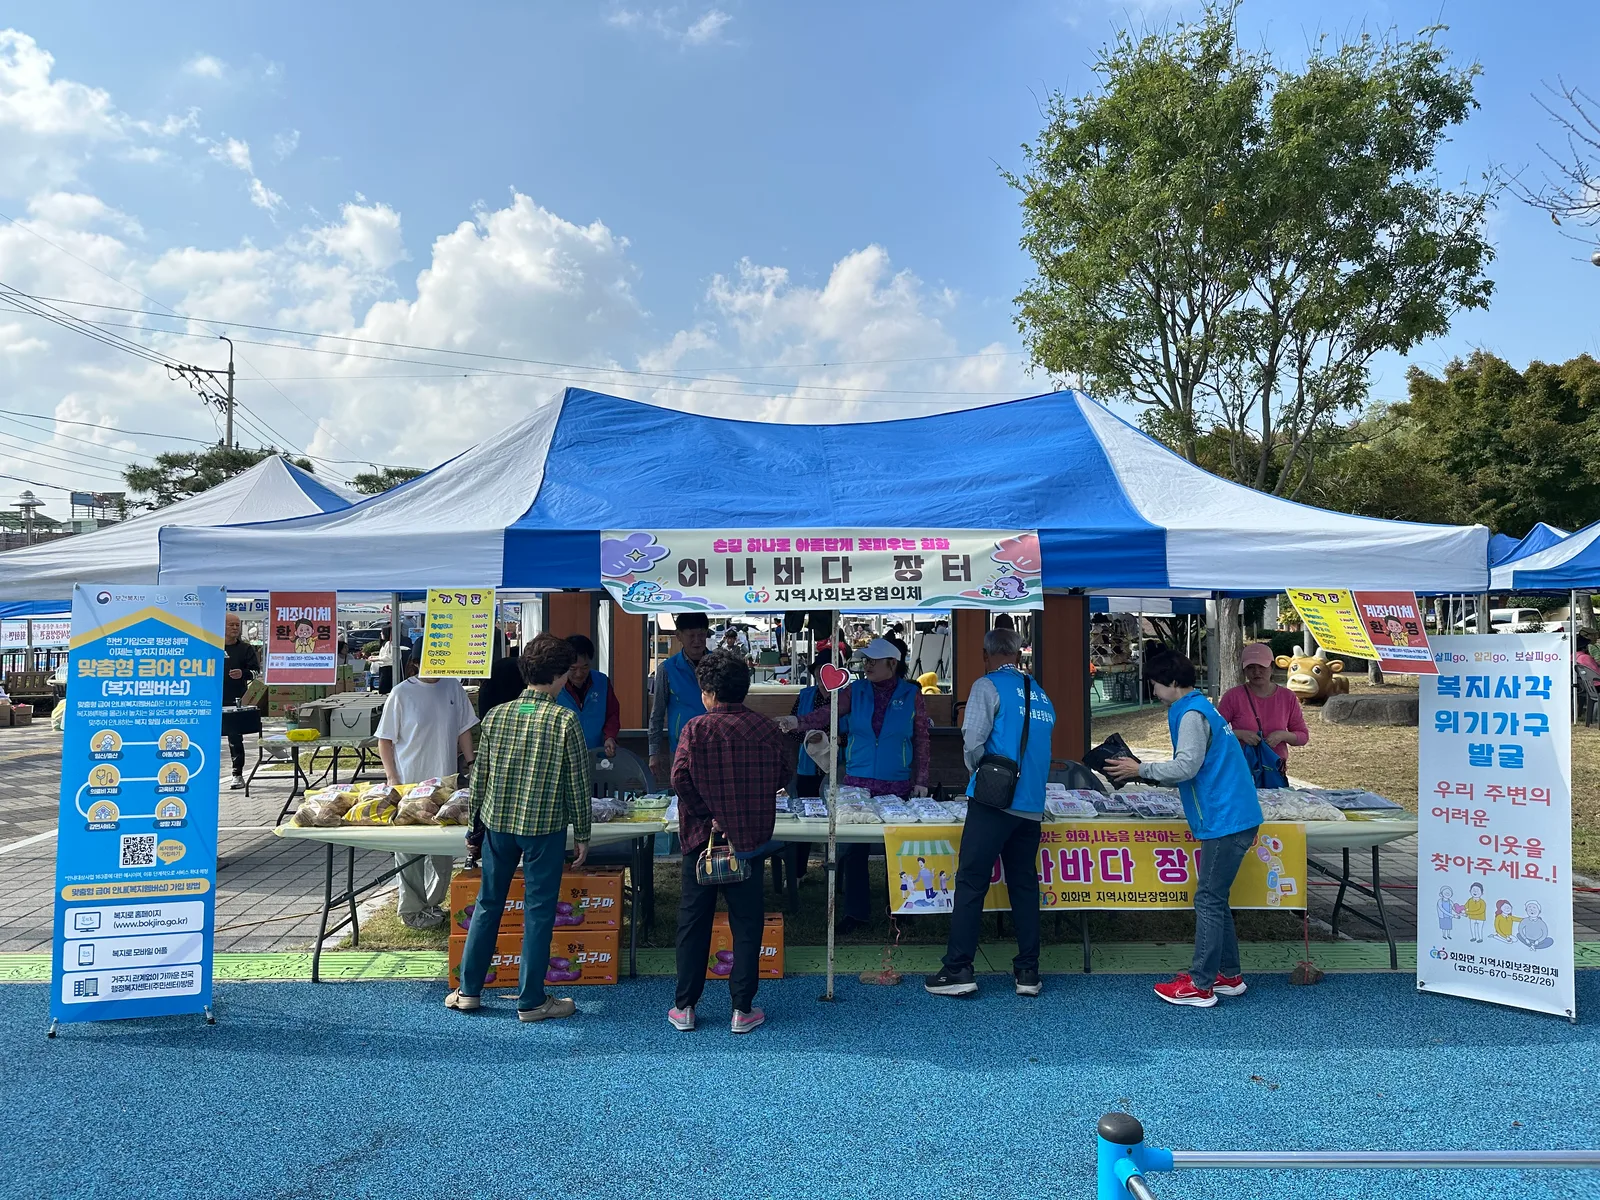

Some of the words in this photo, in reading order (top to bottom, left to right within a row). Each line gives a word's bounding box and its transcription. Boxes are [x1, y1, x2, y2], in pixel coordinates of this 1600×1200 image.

[713, 538, 742, 554] 손길
[747, 538, 791, 553] 하나로
[795, 538, 854, 552] 아름답게
[858, 537, 916, 551] 꽃피우는
[921, 537, 950, 551] 회화
[775, 586, 922, 602] 지역사회보장협의체
[226, 602, 246, 611] 황실
[1363, 605, 1415, 619] 계좌이체
[276, 607, 331, 622] 계좌이체
[106, 638, 122, 646] 한번
[124, 638, 154, 646] 가입으로
[172, 637, 188, 645] 혜택
[109, 648, 133, 656] 이제는
[134, 648, 157, 656] 놓치지
[159, 647, 184, 656] 마세요!
[78, 659, 134, 677] 맞춤형
[138, 659, 175, 677] 급여
[180, 658, 215, 677] 안내
[1437, 675, 1552, 700] 복지사각
[1435, 710, 1550, 737] 위기가구
[1468, 743, 1524, 769] 발굴
[1433, 781, 1474, 801] 우리
[1484, 784, 1551, 807] 주변의
[1431, 807, 1490, 828] 어려운
[1133, 830, 1182, 843] 실천하는
[1185, 830, 1200, 843] 회
[1478, 834, 1545, 859] 이웃을
[1155, 847, 1200, 884] 장
[95, 886, 111, 896] 급여
[170, 883, 185, 892] 가입
[186, 882, 201, 891] 방법
[570, 888, 589, 899] 황토
[578, 897, 615, 909] 고구마
[1061, 891, 1091, 903] 회화면
[1096, 891, 1189, 903] 지역사회보장협의체
[113, 911, 134, 919] 복지로
[135, 909, 162, 919] 홈페이지
[112, 949, 133, 957] 복지로
[133, 947, 153, 956] 모바일
[154, 946, 168, 955] 어플
[567, 943, 585, 953] 황토
[576, 952, 612, 964] 고구마
[1450, 952, 1475, 964] 회화면
[1479, 957, 1559, 978] 지역사회보장협의체
[111, 974, 131, 983] 거주지
[132, 973, 159, 983] 관계없이
[180, 970, 194, 979] 전국
